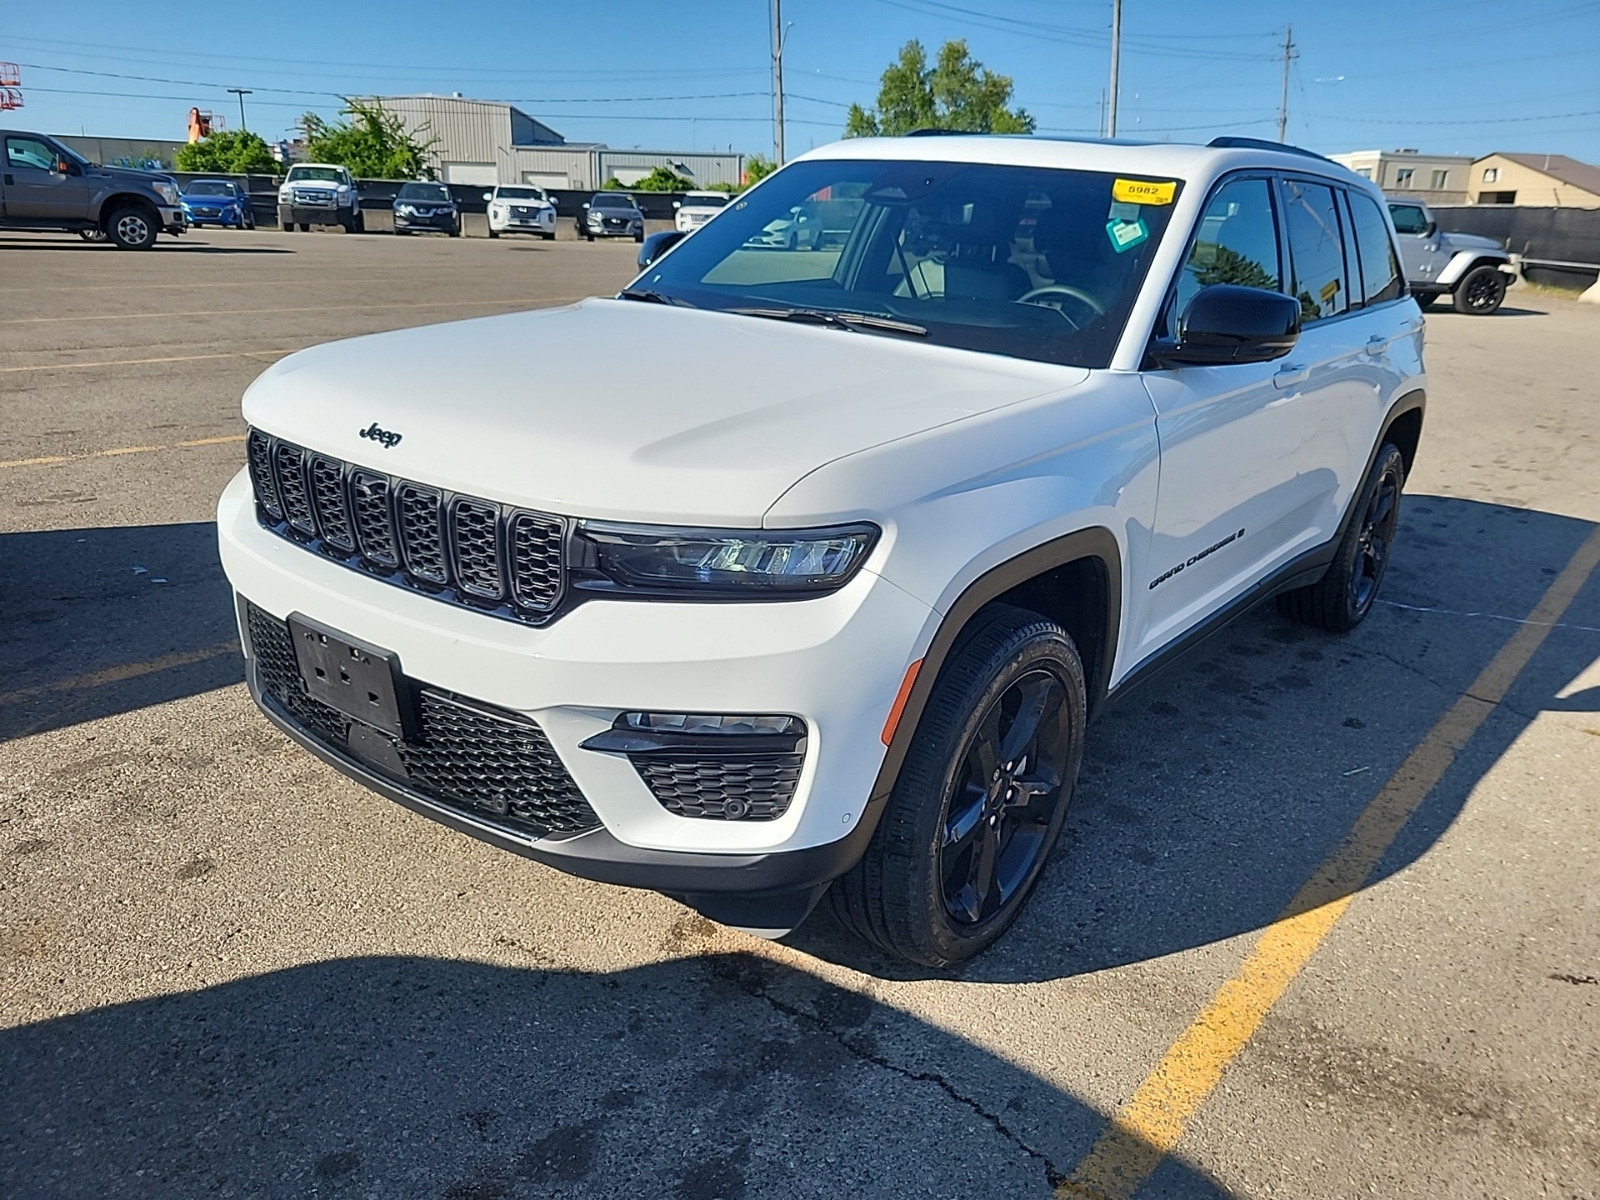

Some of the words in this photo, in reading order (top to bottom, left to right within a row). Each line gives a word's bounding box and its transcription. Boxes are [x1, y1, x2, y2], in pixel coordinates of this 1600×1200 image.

[1128, 186, 1159, 195] 5982
[359, 422, 403, 449] Jeep
[1148, 562, 1185, 590] GRAND
[1186, 532, 1237, 567] CHEROKEE
